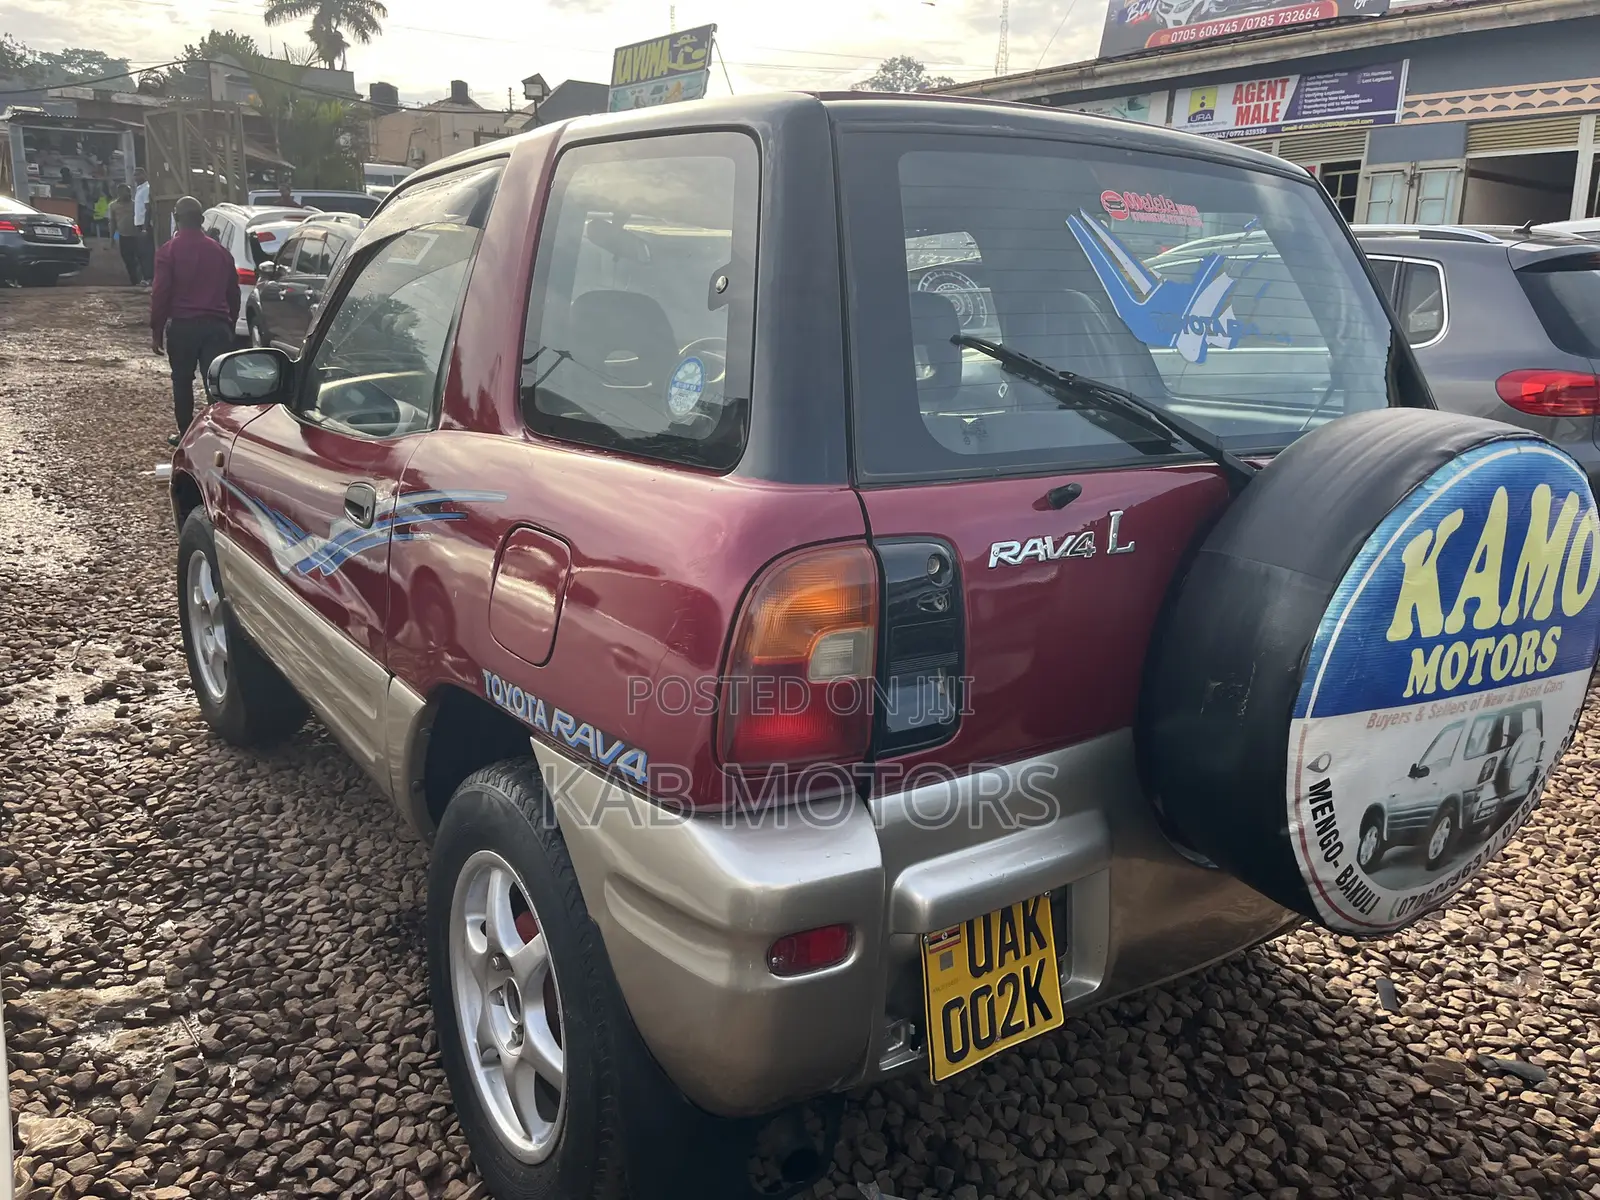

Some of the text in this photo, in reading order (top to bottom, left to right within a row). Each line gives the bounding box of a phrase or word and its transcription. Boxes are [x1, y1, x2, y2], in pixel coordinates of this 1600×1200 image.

[1170, 30, 1196, 43] 0705
[1199, 20, 1238, 39] 606745
[1278, 6, 1320, 25] 732664
[613, 38, 671, 86] KAVUMA
[1232, 77, 1290, 105] AGENT
[1190, 113, 1213, 123] URA
[1235, 101, 1281, 126] MALE
[988, 510, 1136, 569] RAV4 L
[1386, 483, 1600, 642] KAMO
[1402, 626, 1562, 698] MOTORS
[482, 668, 649, 785] TOYOTA RAV4
[1366, 711, 1412, 731] Buyers
[1428, 700, 1468, 719] Sellers
[1308, 777, 1381, 916] MENGO- BAKULI
[966, 894, 1047, 979] UAK
[941, 957, 1053, 1064] 002K
